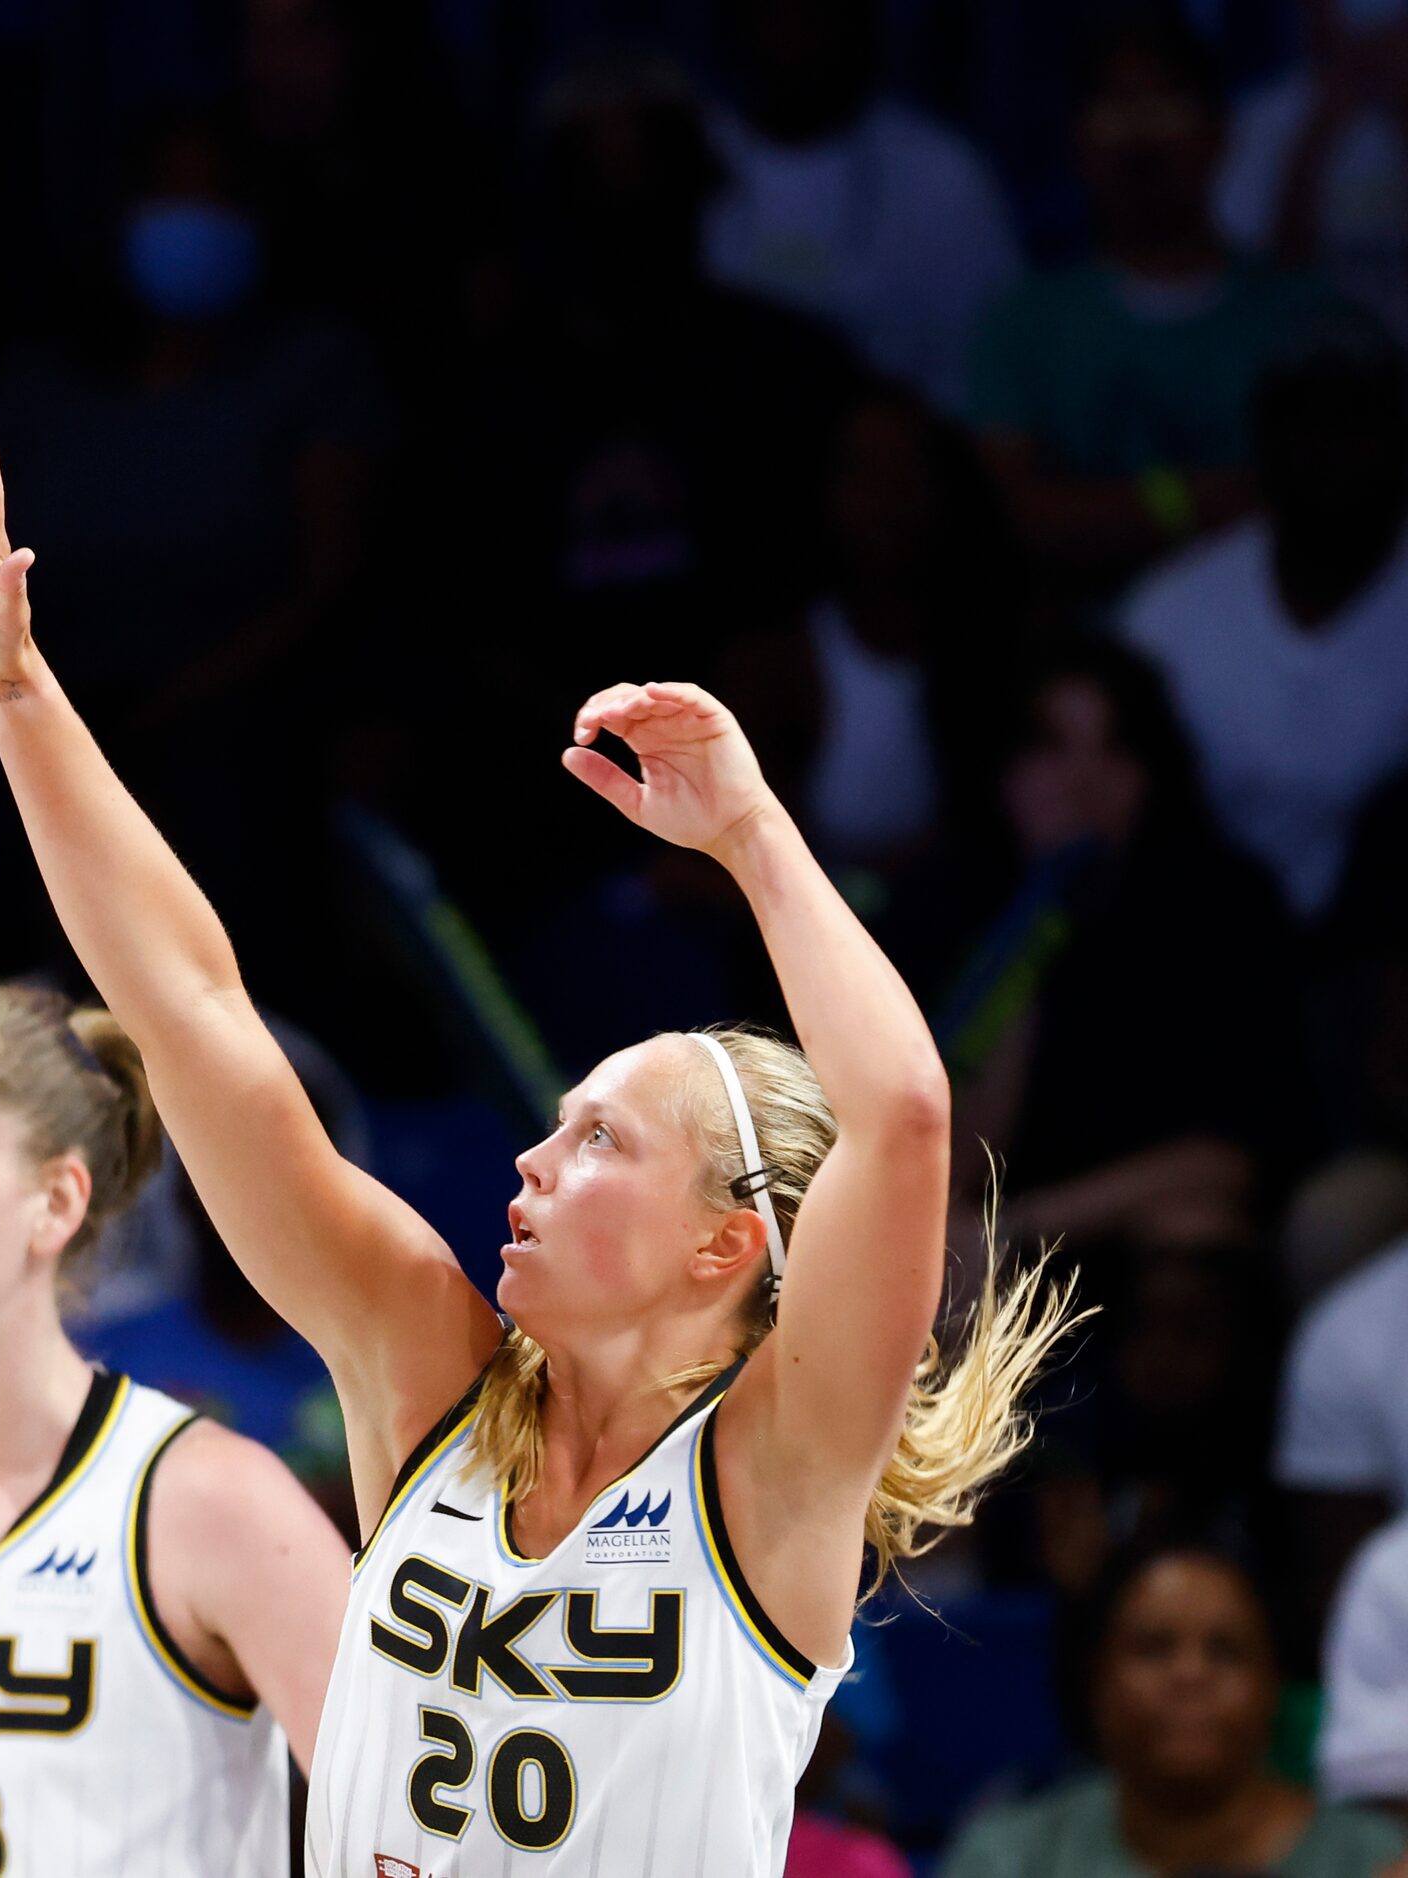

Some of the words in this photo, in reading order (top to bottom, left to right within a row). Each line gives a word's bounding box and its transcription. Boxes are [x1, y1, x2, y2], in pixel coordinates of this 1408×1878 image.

[586, 1551, 671, 1559] CORPORATION
[587, 1534, 671, 1547] MAGELLAN
[368, 1552, 688, 1704] SKY
[407, 1703, 579, 1855] 20
